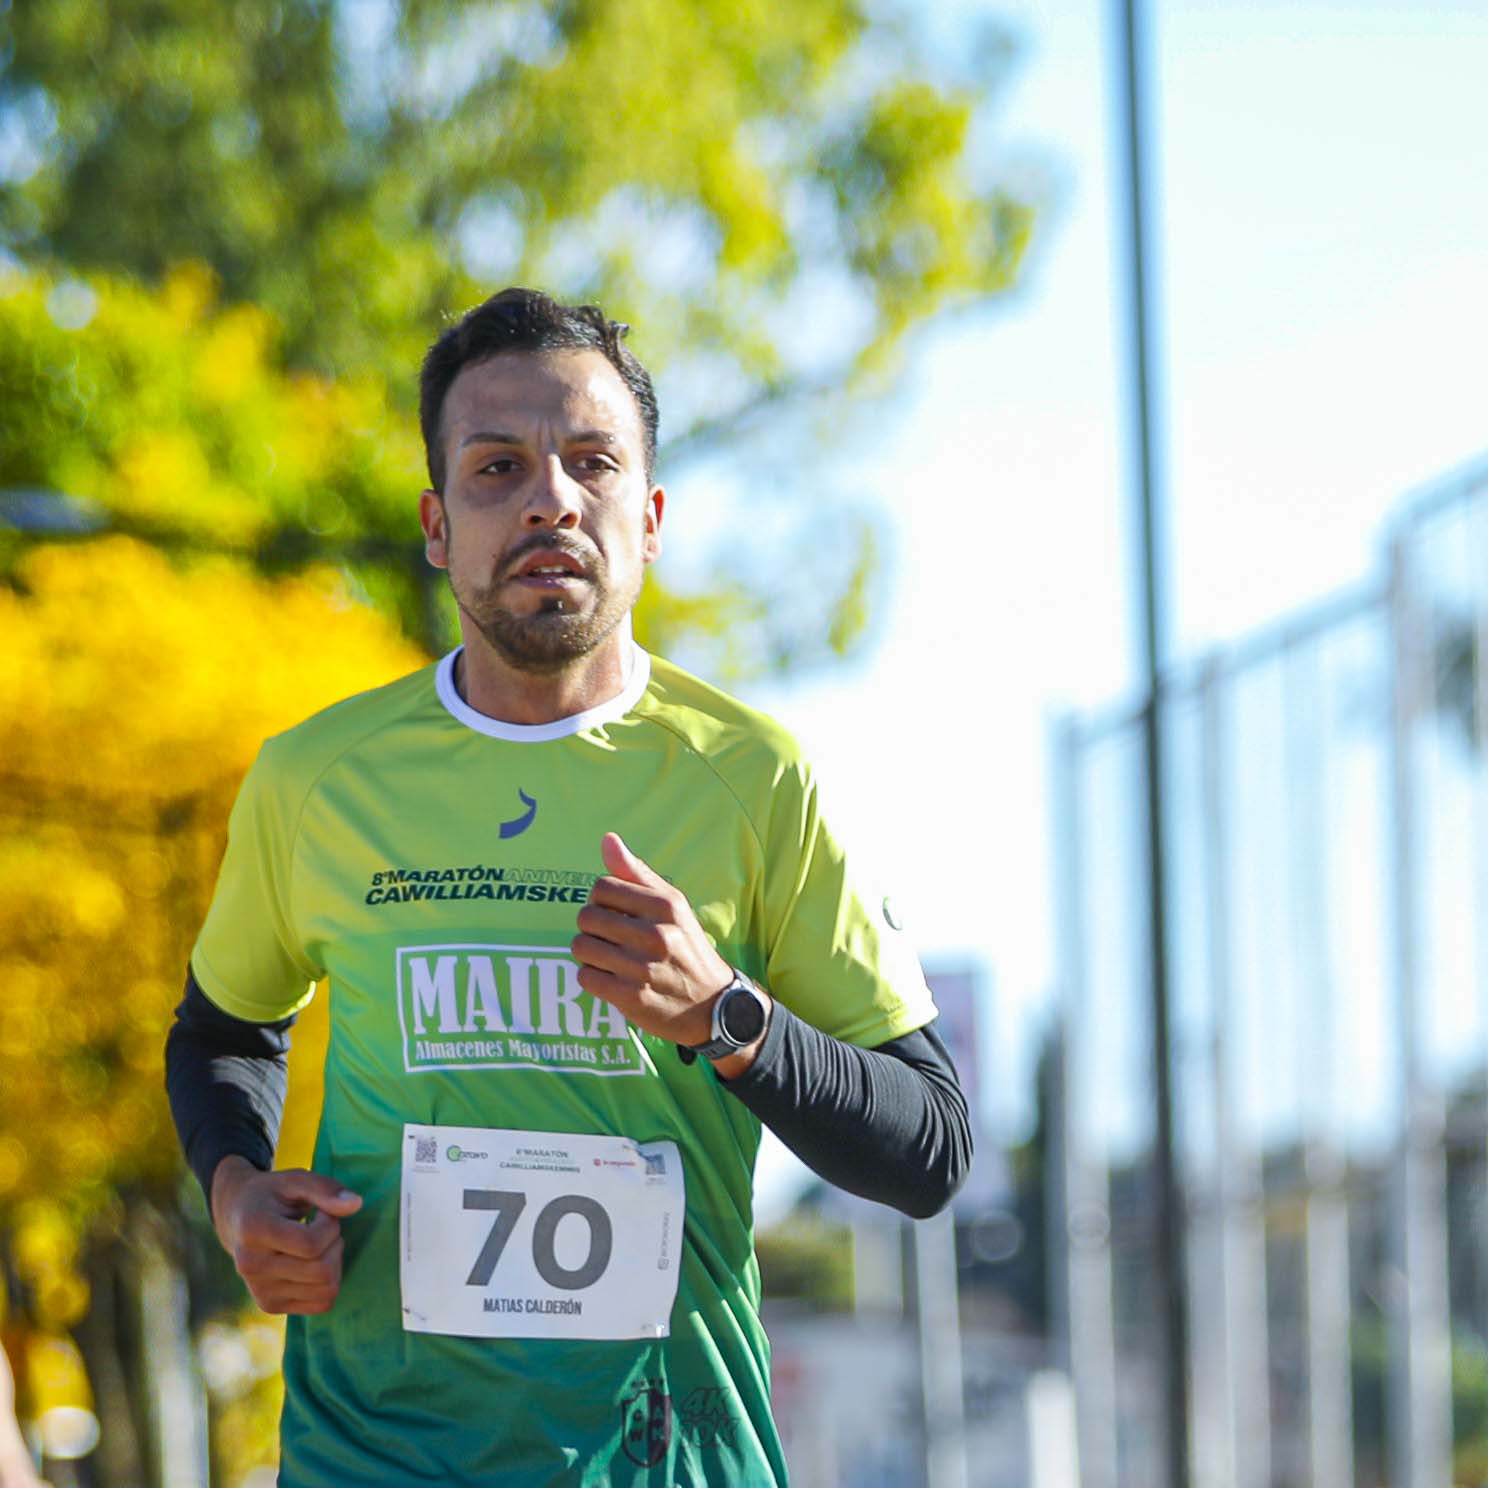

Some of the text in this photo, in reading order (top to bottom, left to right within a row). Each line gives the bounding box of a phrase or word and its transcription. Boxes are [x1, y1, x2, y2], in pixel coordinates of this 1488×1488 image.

[365, 883, 588, 905] CAWILLIAMSKE
[415, 1039, 631, 1065] Almacenes Mayoristas S.A.
[462, 1188, 613, 1291] 70
[483, 1298, 583, 1315] MATIAS CALDERÓN
